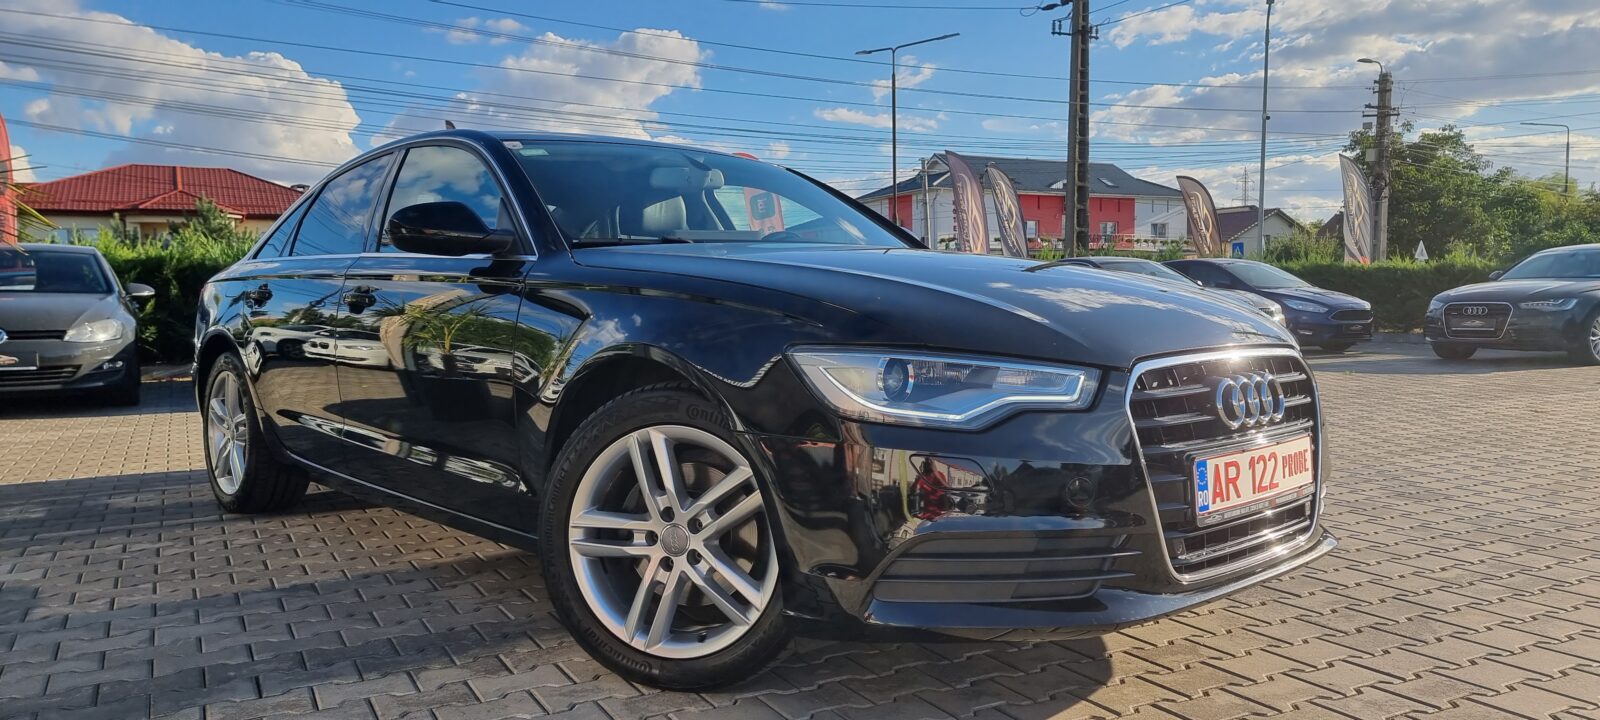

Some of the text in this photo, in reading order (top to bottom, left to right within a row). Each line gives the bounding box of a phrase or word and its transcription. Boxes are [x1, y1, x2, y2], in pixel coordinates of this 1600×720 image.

[1212, 461, 1241, 504] AR
[1249, 452, 1279, 494] 122
[1282, 449, 1309, 479] PROBE
[1198, 490, 1209, 506] RO
